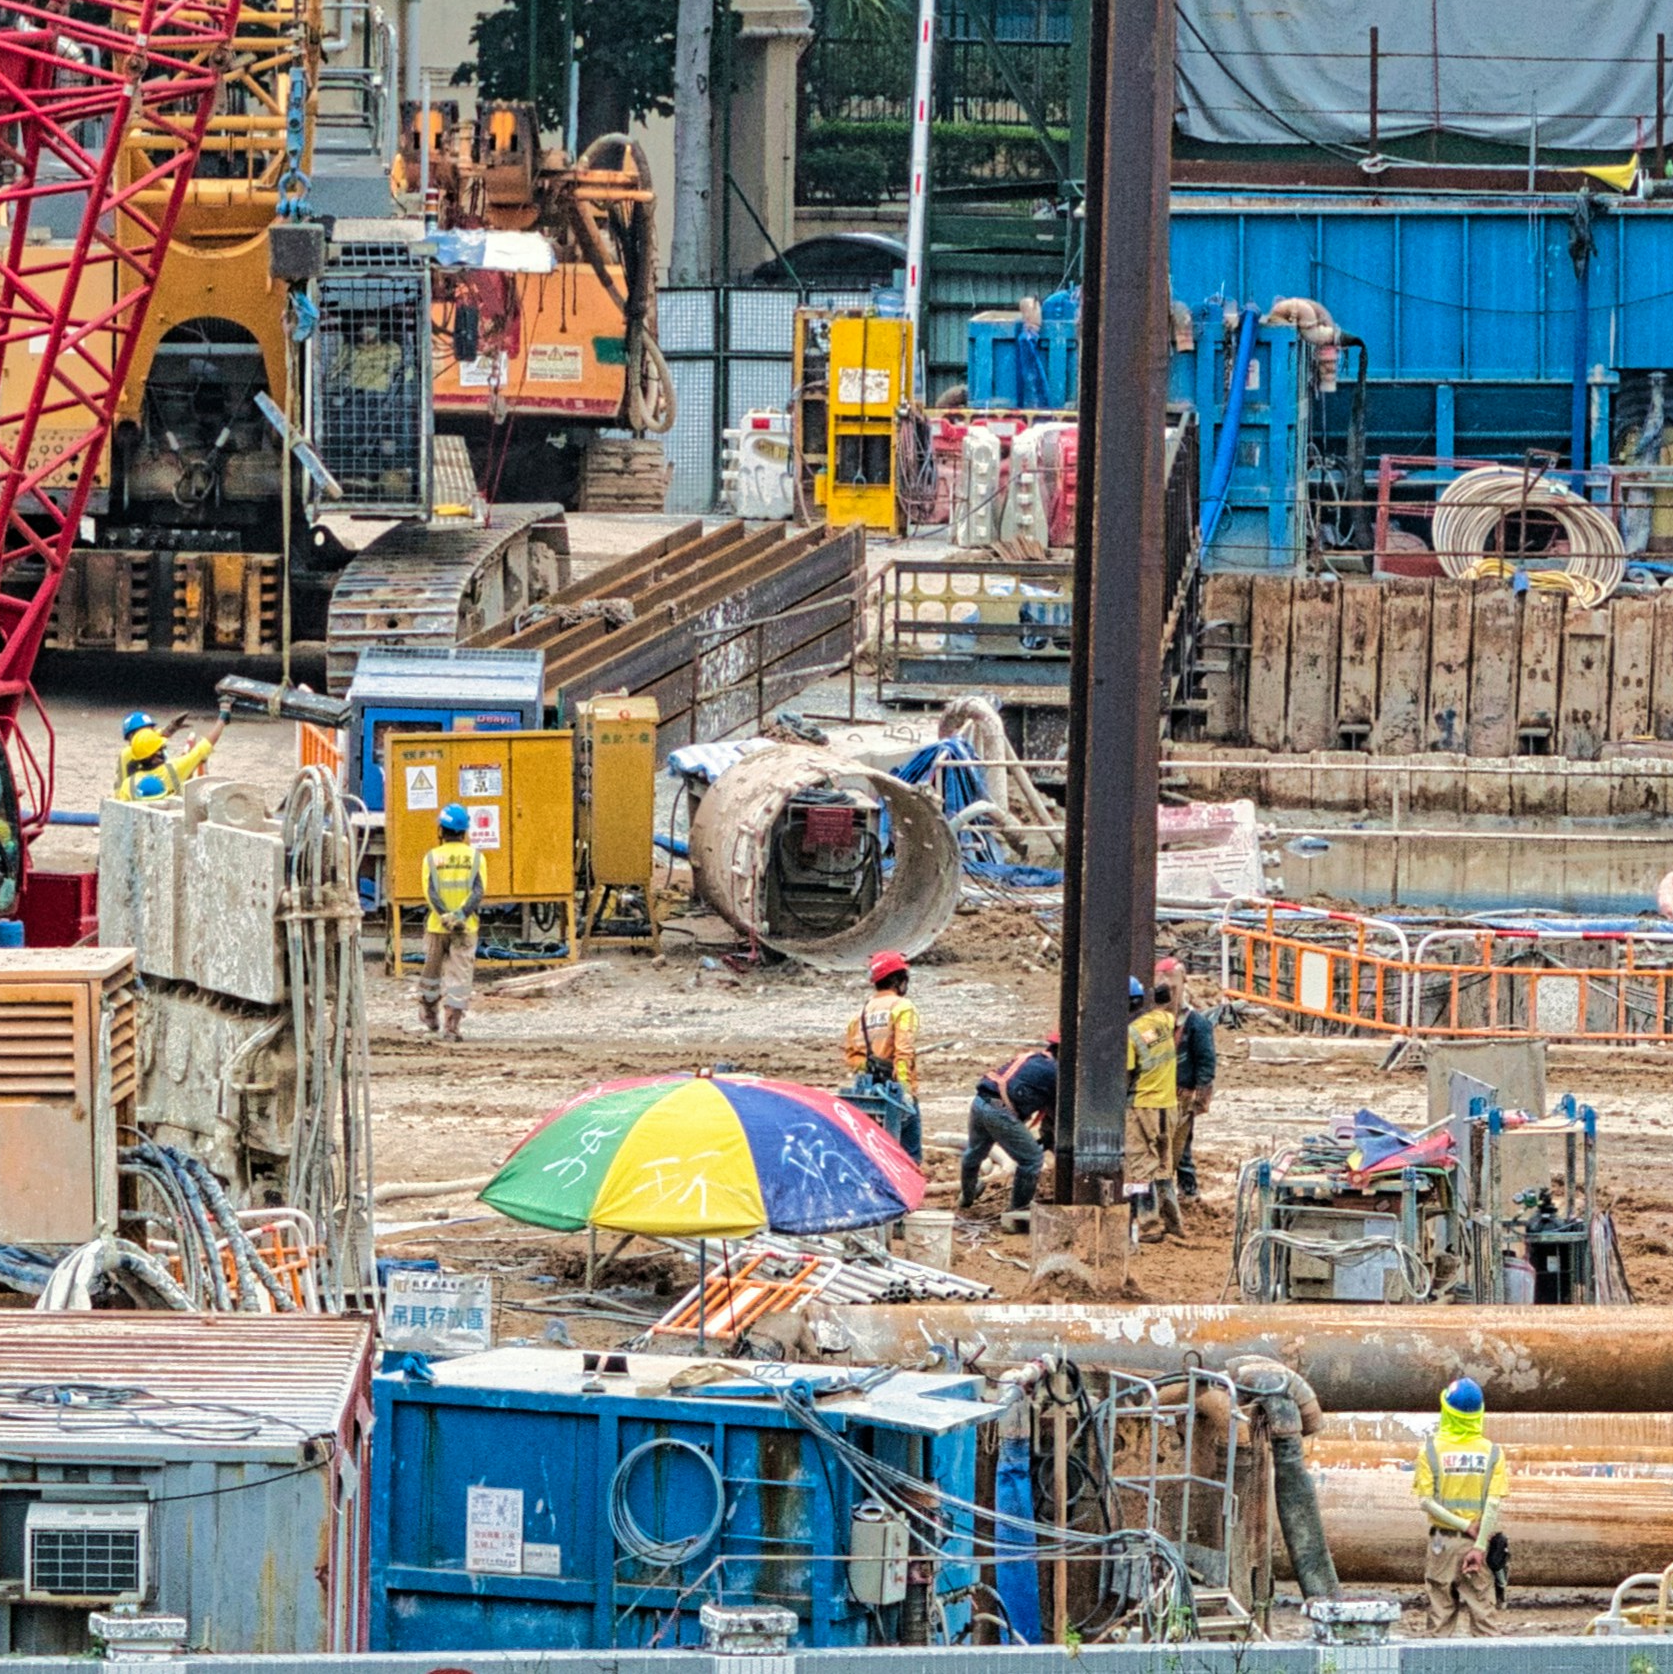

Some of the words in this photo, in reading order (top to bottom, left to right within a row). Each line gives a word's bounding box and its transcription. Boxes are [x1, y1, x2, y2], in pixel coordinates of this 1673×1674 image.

[391, 1304, 484, 1330] 吊具存放區
